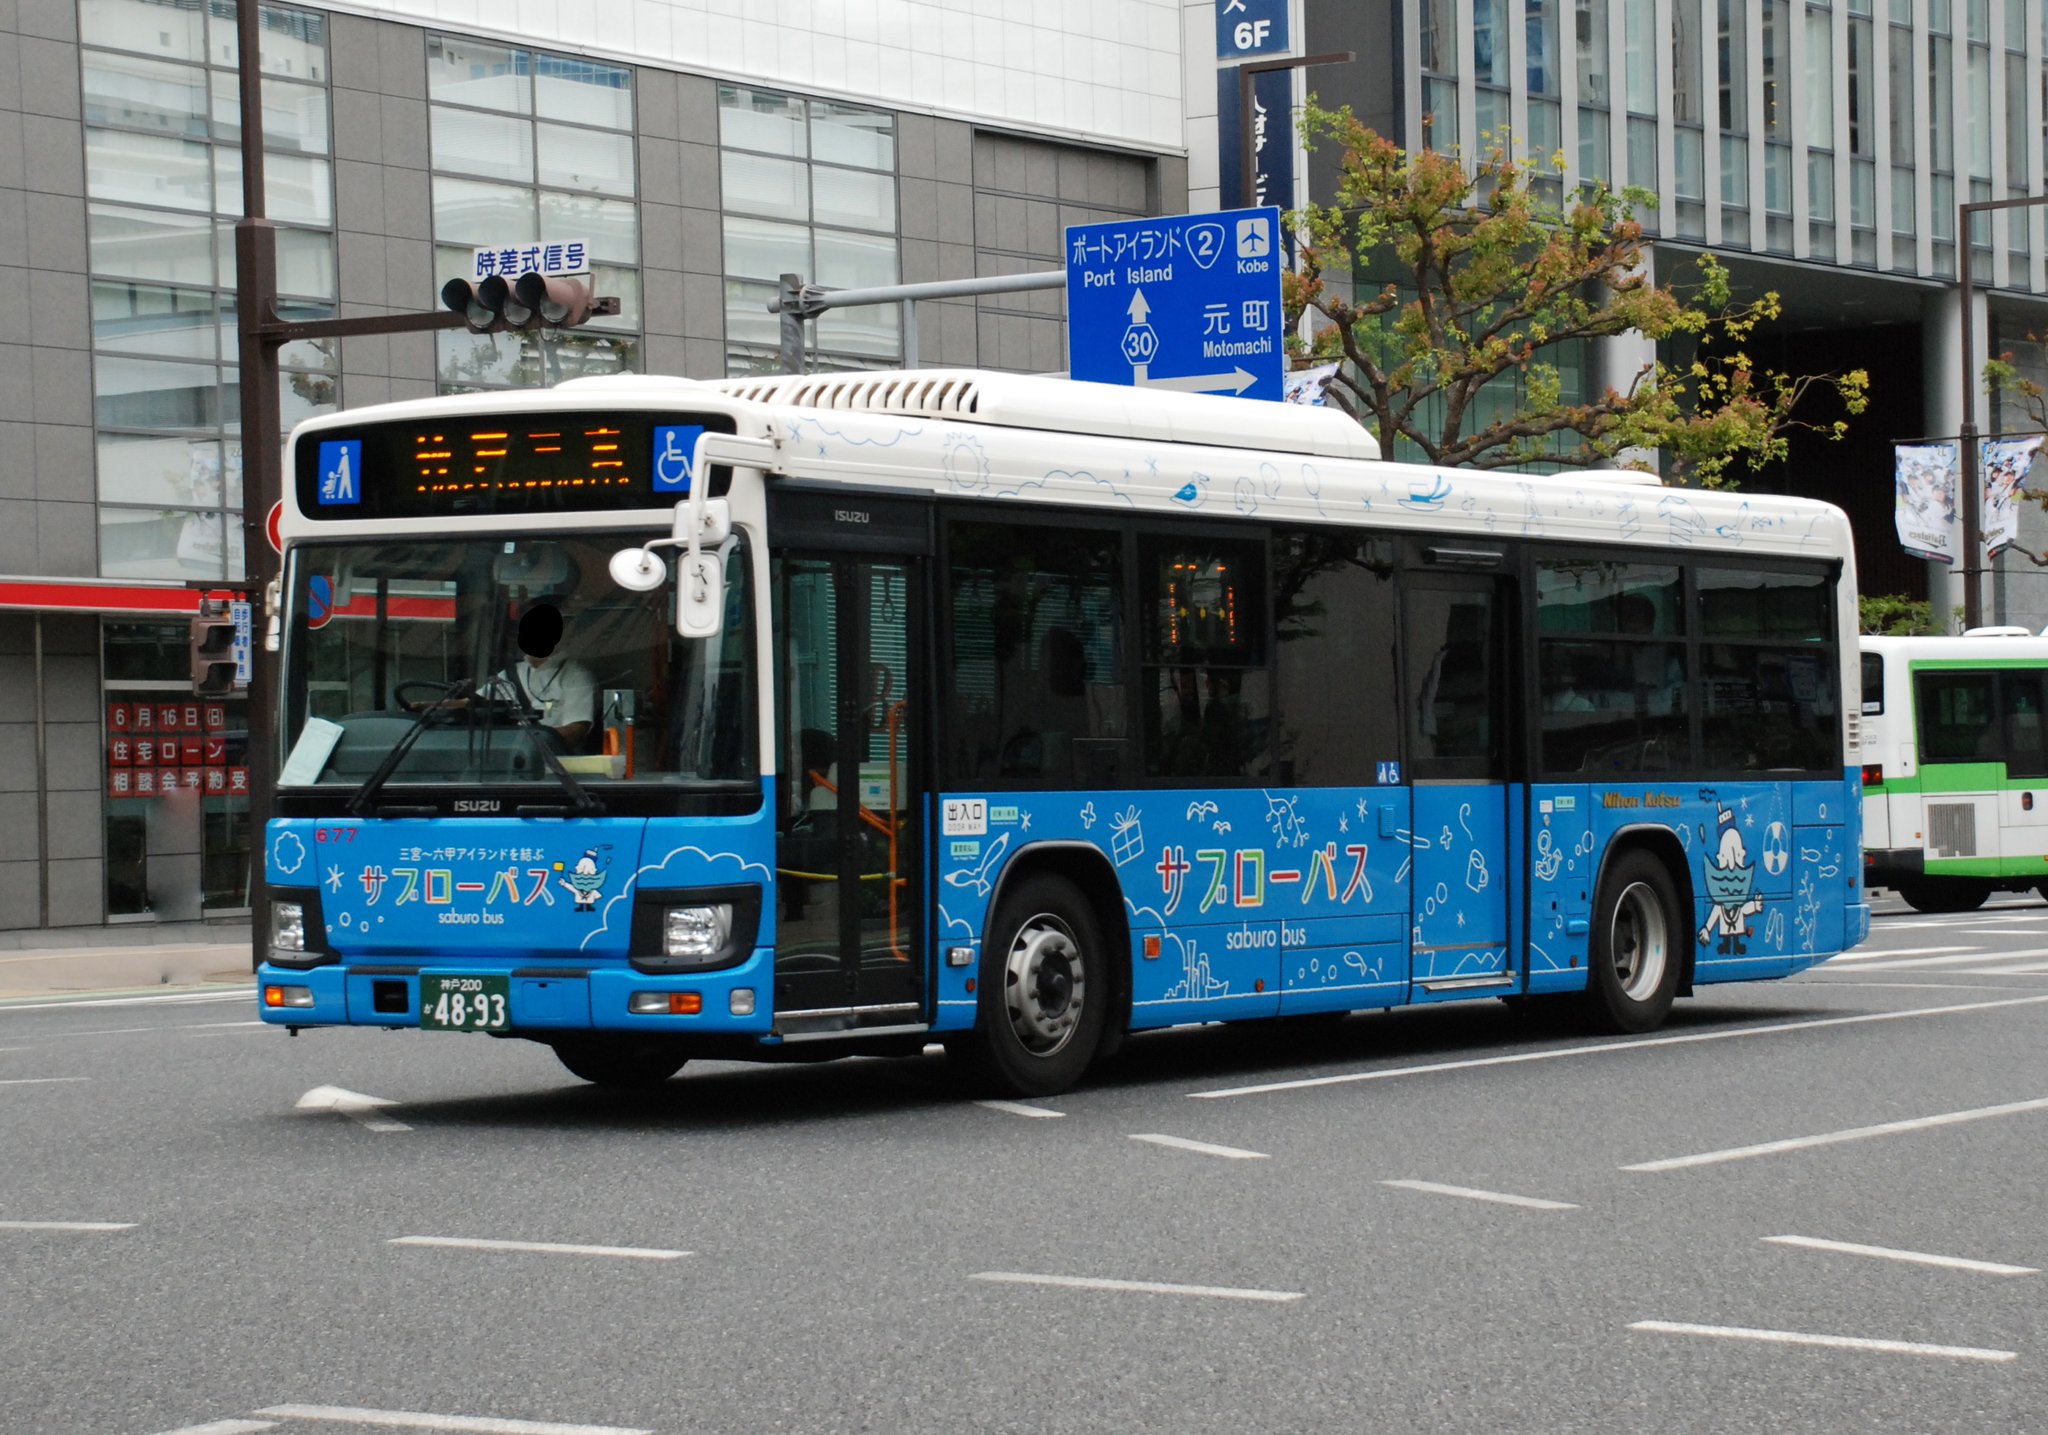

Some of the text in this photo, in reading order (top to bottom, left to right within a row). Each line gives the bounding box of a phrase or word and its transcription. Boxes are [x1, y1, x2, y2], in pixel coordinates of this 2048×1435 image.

[1234, 19, 1271, 50] 6F
[1073, 226, 1181, 266] ポートアイランド
[1197, 230, 1213, 256] 2
[476, 243, 585, 277] 時差式信号
[1236, 259, 1269, 275] Kobe
[1084, 264, 1173, 288] Port Island
[1203, 300, 1270, 335] 元町
[1127, 331, 1153, 357] 30
[1203, 336, 1272, 359] Motomachi
[834, 509, 870, 523] ISUZU
[113, 741, 222, 760] 住宅ローン
[454, 800, 501, 812] ISUZU
[947, 803, 982, 821] 出入口
[316, 828, 358, 843] 677
[358, 865, 555, 907] サブローバス
[1155, 842, 1373, 916] サブローバス
[438, 907, 504, 925] saburo bus
[1226, 918, 1307, 950] saburo bus
[434, 992, 505, 1027] 48-93
